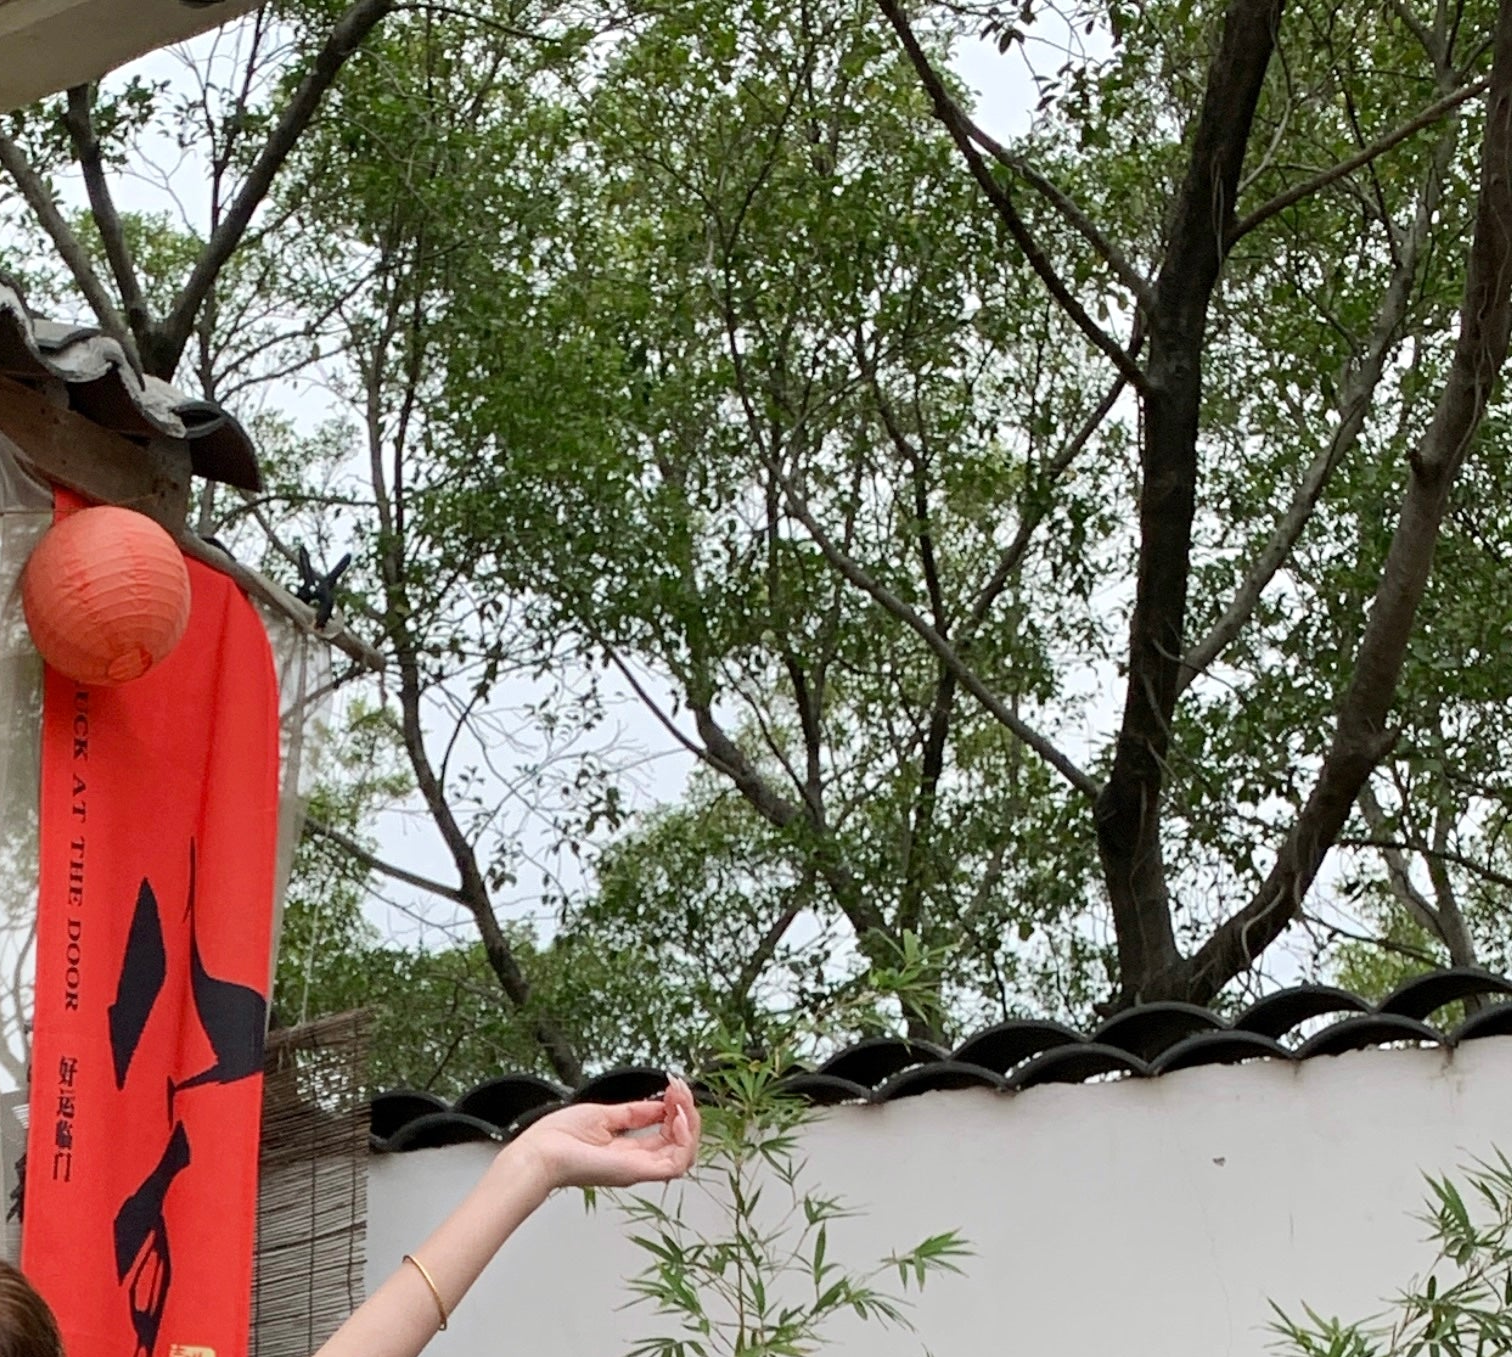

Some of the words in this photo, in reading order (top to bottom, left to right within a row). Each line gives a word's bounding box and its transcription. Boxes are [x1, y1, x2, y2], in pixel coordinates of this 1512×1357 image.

[72, 772, 87, 824] AT
[68, 835, 86, 907] THE
[64, 917, 82, 1012] DOOR
[52, 1055, 79, 1183] 好运临门
